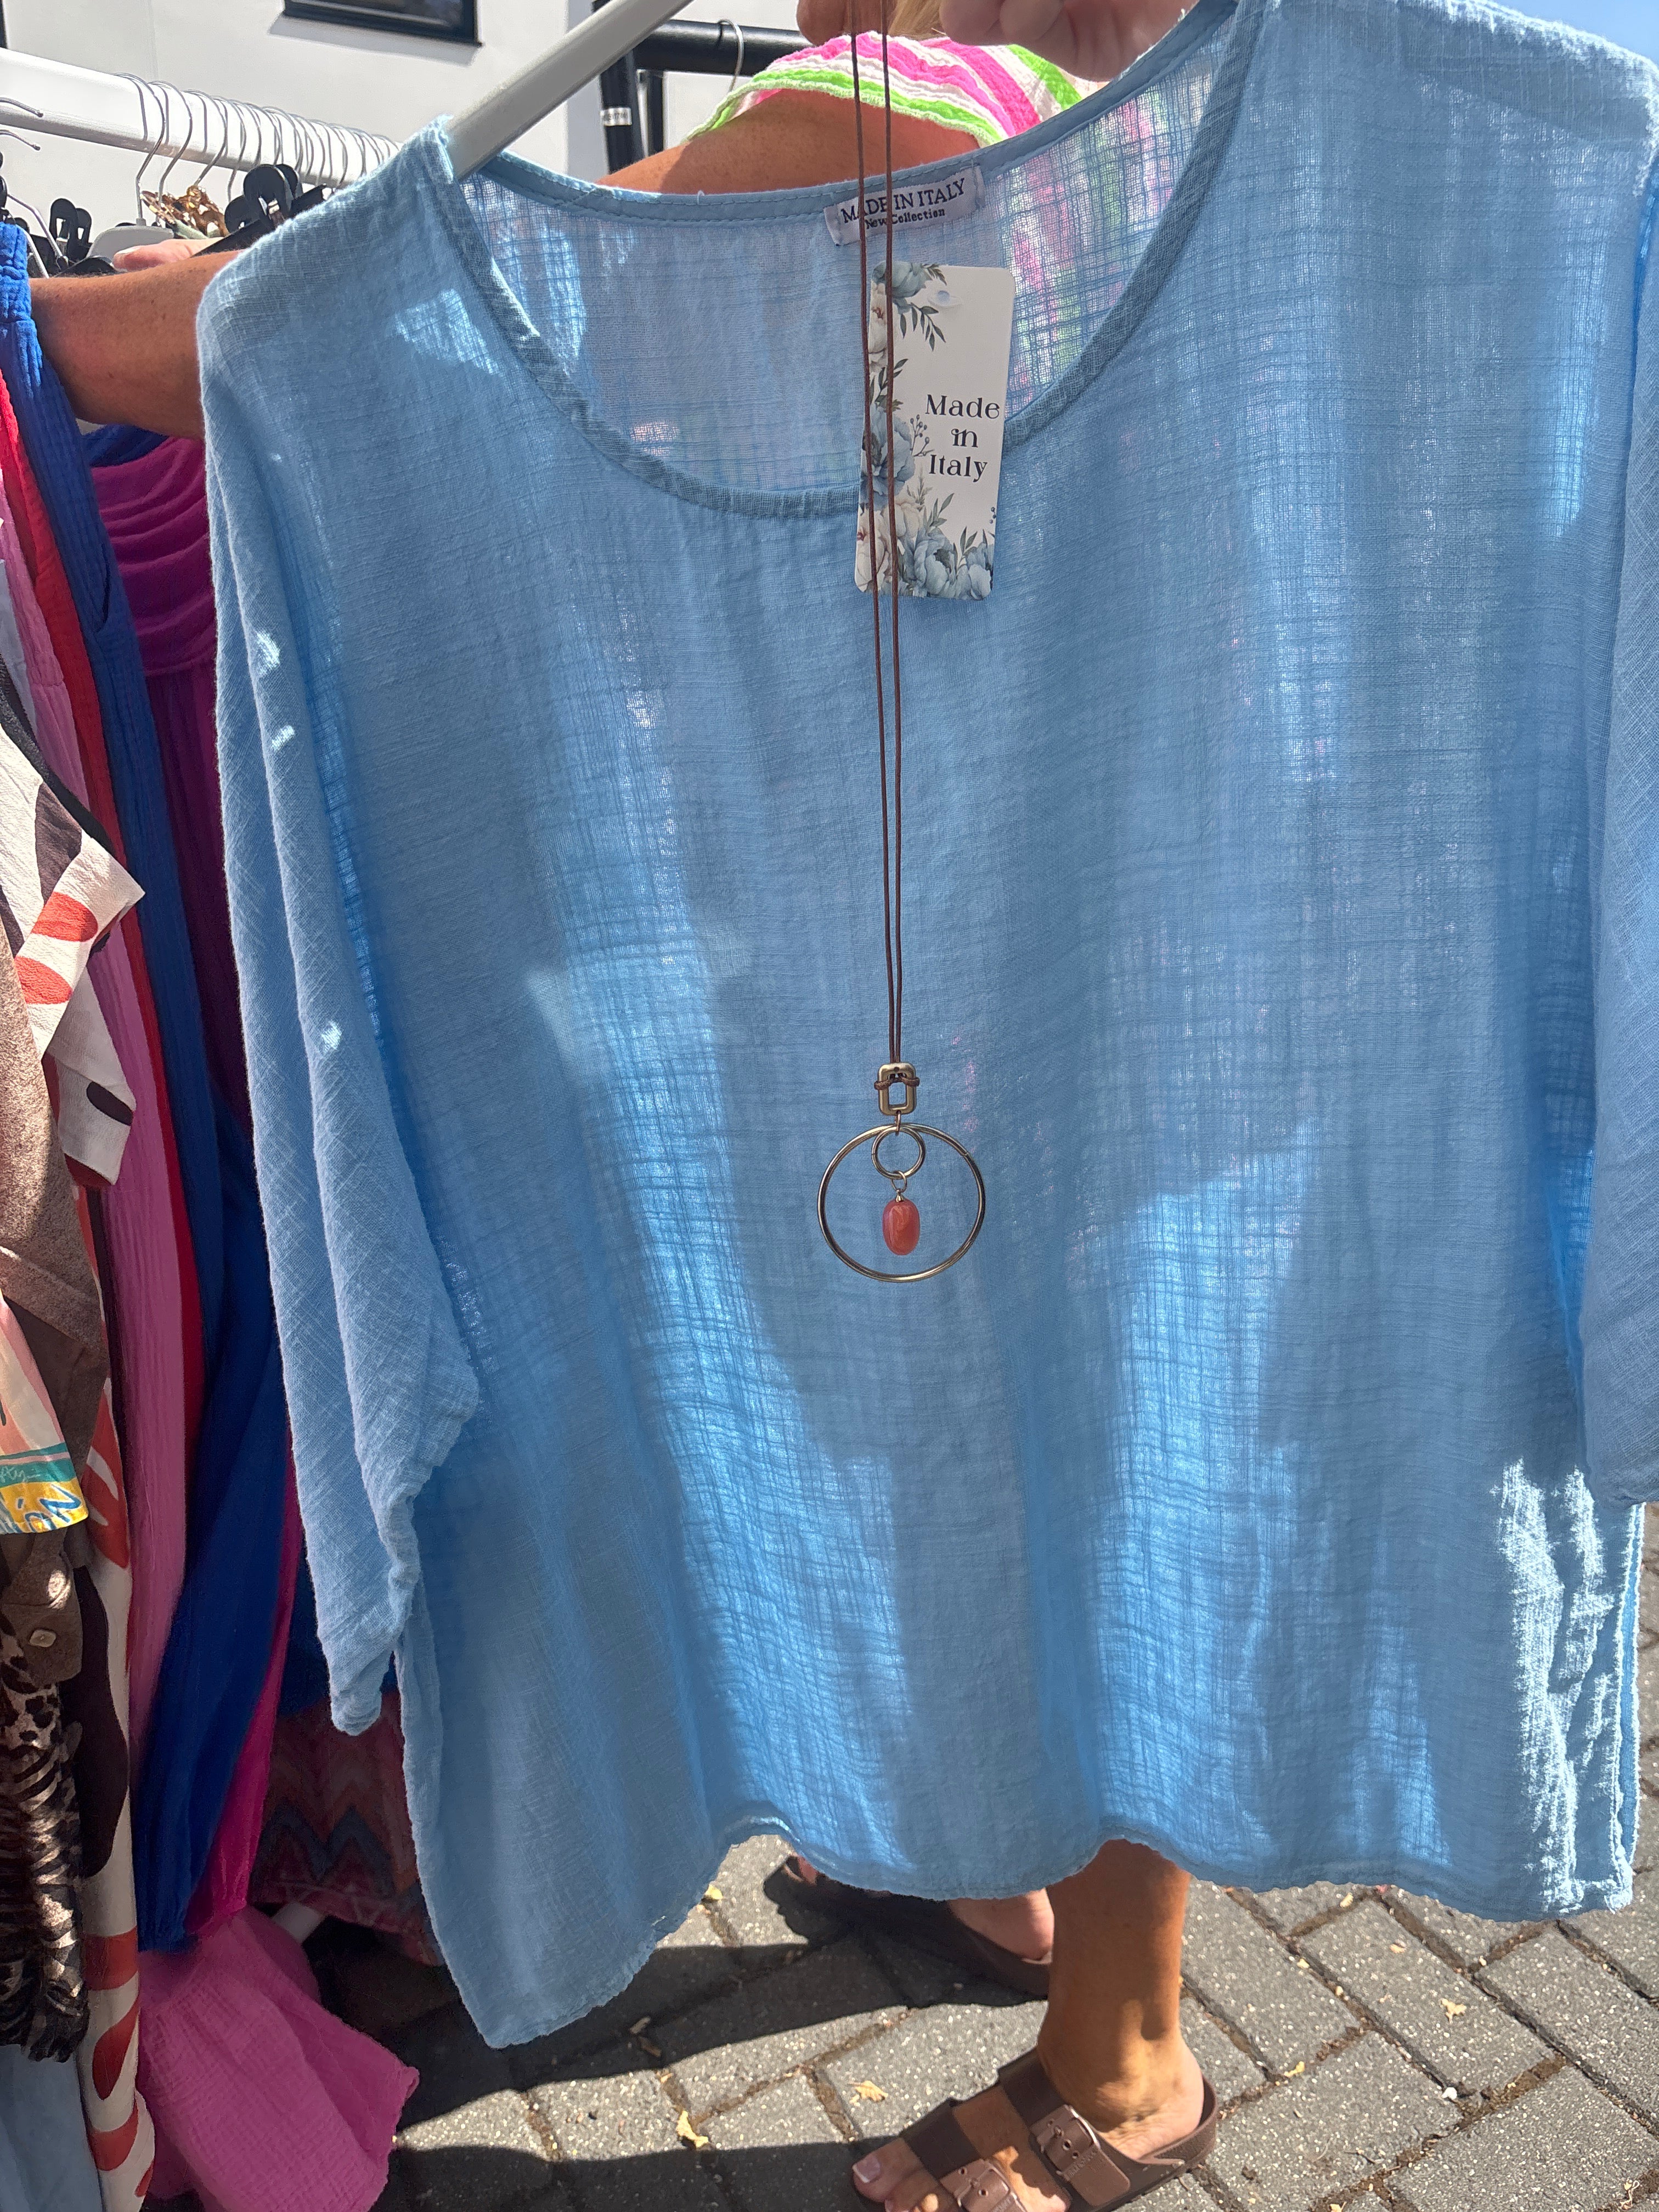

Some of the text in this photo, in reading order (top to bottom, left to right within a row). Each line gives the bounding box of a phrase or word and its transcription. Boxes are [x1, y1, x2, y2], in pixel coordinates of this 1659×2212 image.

[893, 192, 915, 210] IN
[917, 178, 965, 207] ITALY
[865, 207, 946, 229] New Collection
[925, 394, 1000, 419] Made
[951, 428, 978, 448] in
[928, 454, 988, 483] Italy
